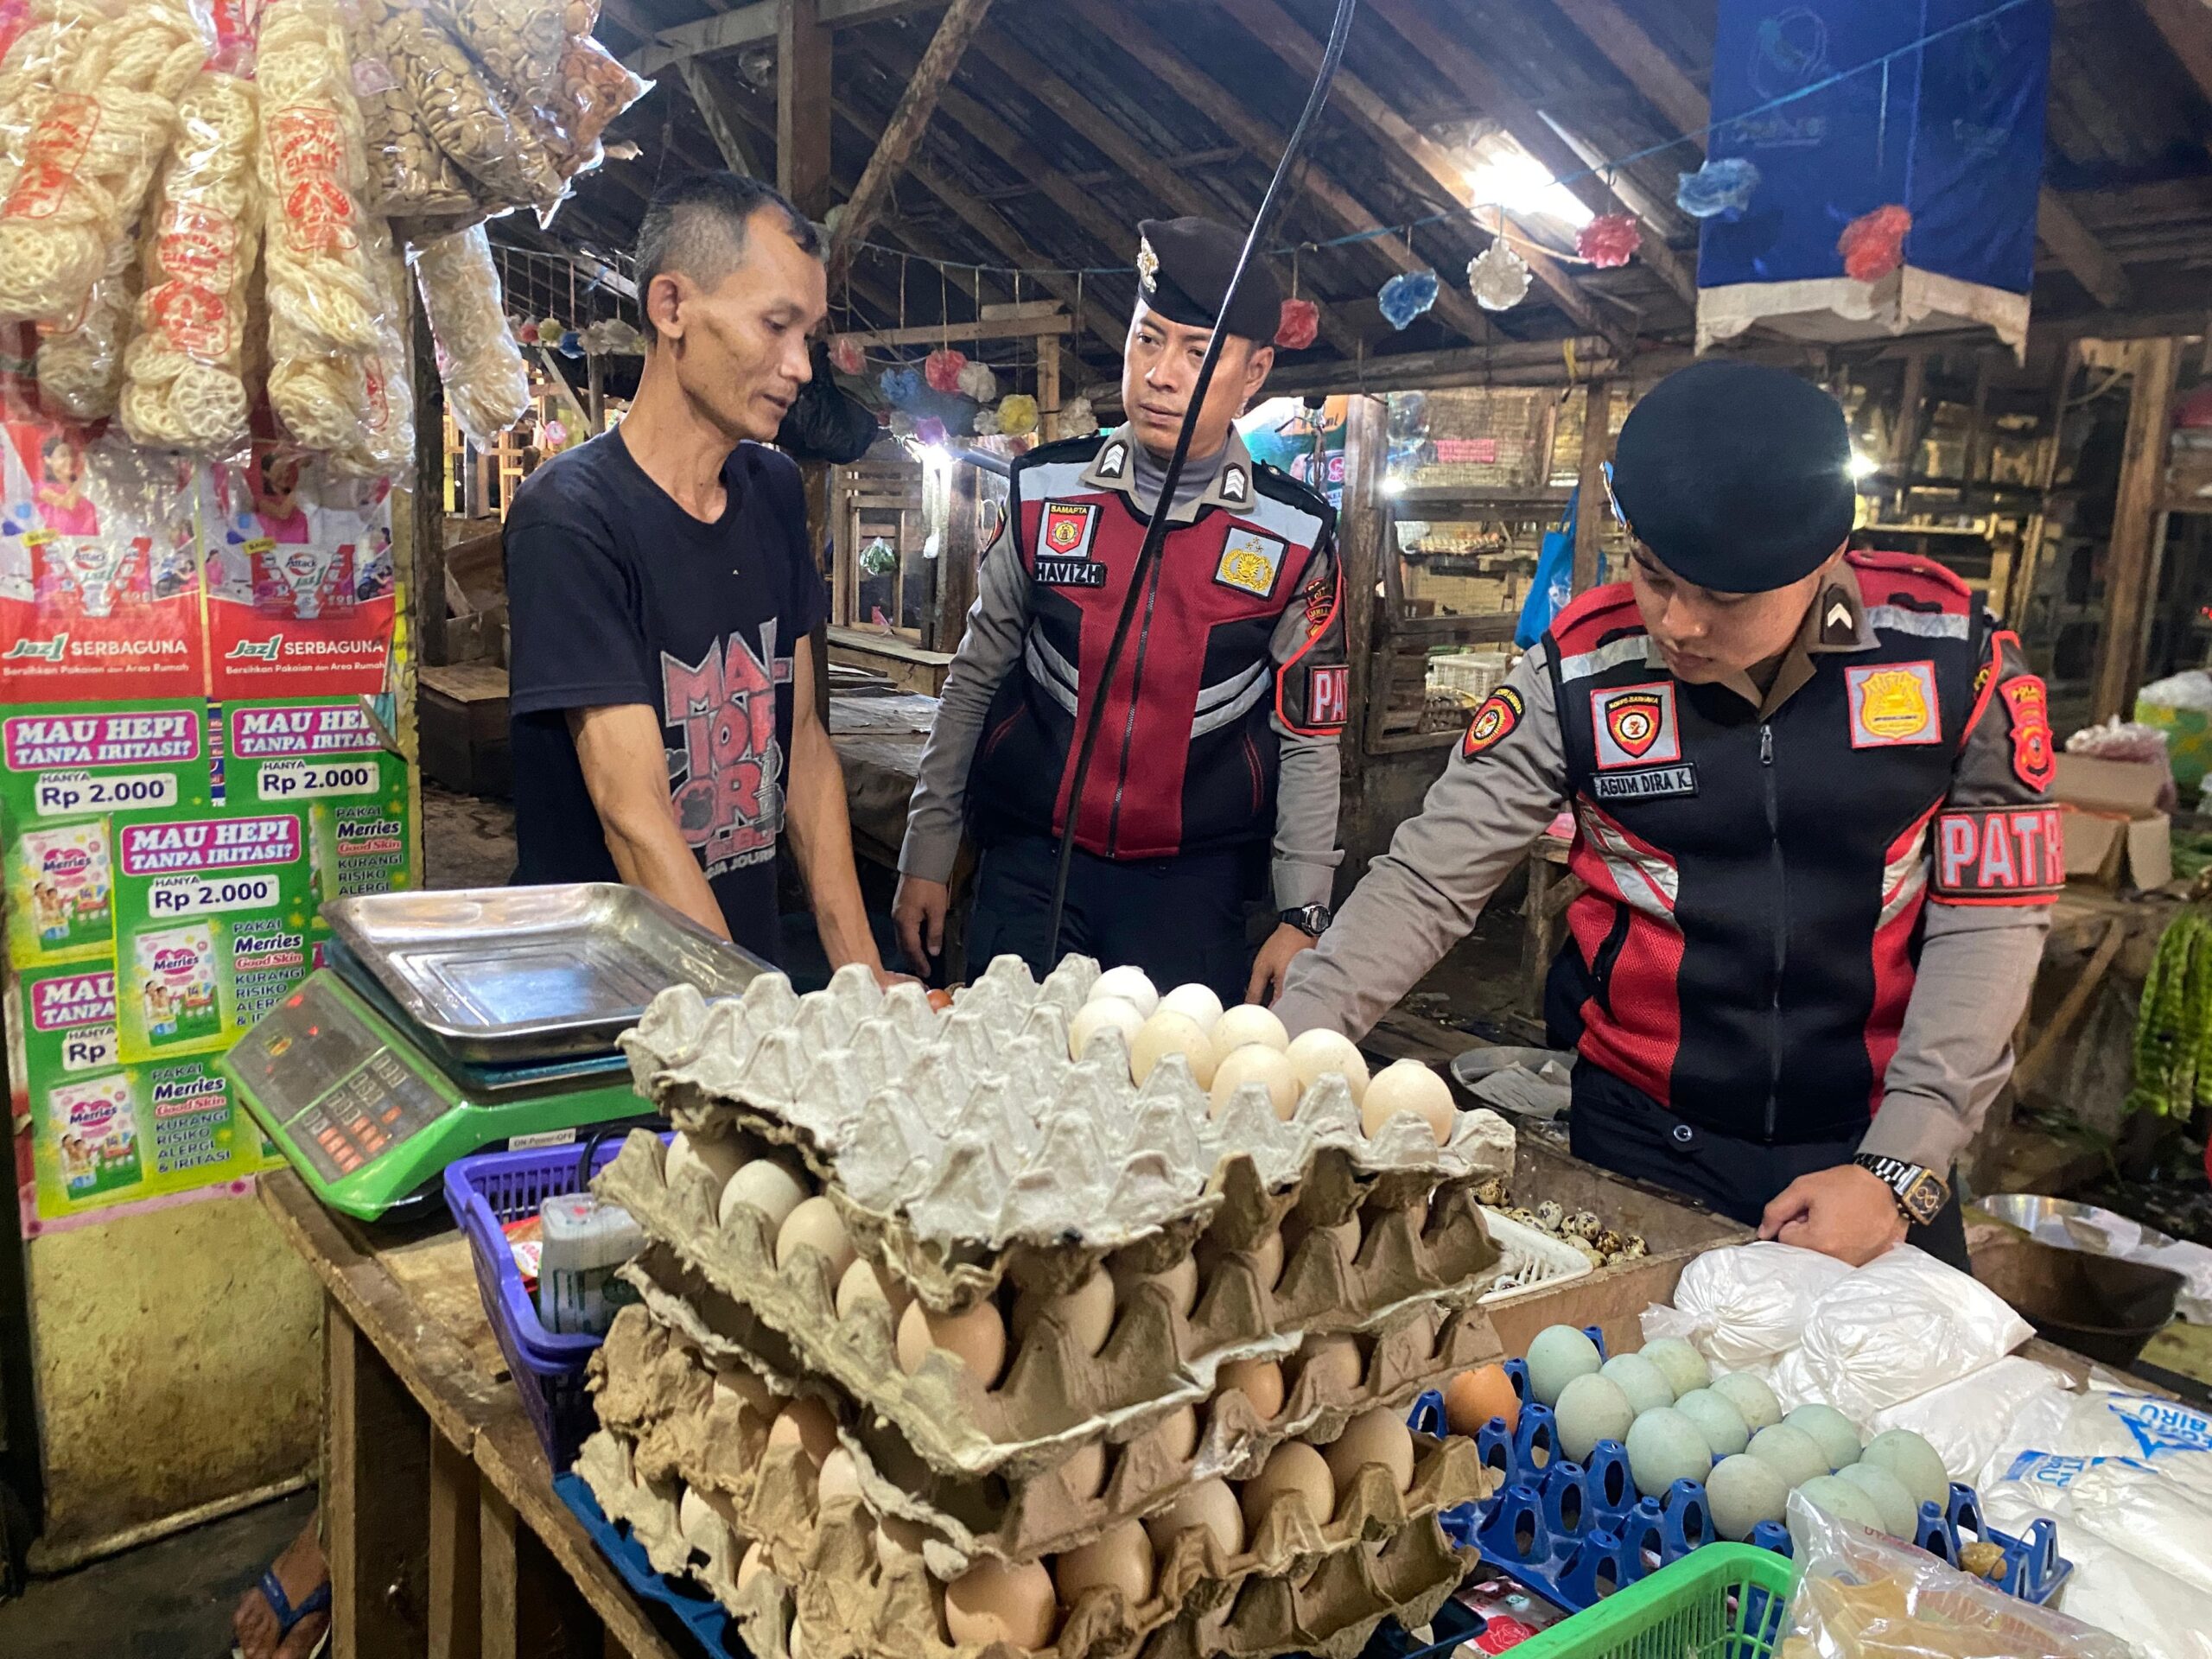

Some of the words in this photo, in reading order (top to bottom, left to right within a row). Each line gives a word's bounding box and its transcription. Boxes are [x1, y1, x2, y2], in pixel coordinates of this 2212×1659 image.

[1051, 505, 1088, 514] SAMAPTA
[1036, 563, 1101, 584] HAVIZH
[71, 640, 188, 656] SERBAGUNA
[284, 640, 385, 655] SERBAGUNA
[3, 666, 58, 677] Bersihkan
[60, 664, 105, 675] Pakaian
[125, 664, 150, 673] Area
[154, 663, 188, 672] Rumah
[226, 664, 273, 675] Bersihkan
[276, 664, 313, 673] Pakaian
[331, 662, 353, 671] Area
[354, 661, 385, 671] Rumah
[1313, 670, 1348, 722] PA
[16, 719, 98, 746] MAU
[106, 716, 187, 741] HEPI
[242, 712, 313, 734] MAU
[16, 747, 92, 765] TANPA
[98, 741, 192, 760] IRITASI?
[242, 736, 307, 753] TANPA
[263, 761, 305, 770] HANYA
[41, 772, 90, 783] HANYA
[264, 774, 296, 794] Rp
[304, 768, 368, 789] 2.000
[1600, 777, 1639, 796] AGUM
[1641, 772, 1674, 792] DIRA
[1677, 770, 1690, 788] K
[42, 786, 79, 809] Rp
[88, 780, 164, 803] 2.000
[336, 807, 381, 817] PAKAI
[130, 826, 208, 851] MAU
[215, 821, 289, 845] HEPI
[338, 820, 399, 839] Merries
[339, 842, 372, 855] Good
[373, 839, 401, 851] Skin
[44, 856, 92, 872] Merries
[130, 850, 201, 870] TANPA
[207, 844, 293, 863] IRITASI?
[339, 855, 402, 868] KURANGI
[155, 876, 200, 887] HANYA
[339, 870, 386, 882] RISIKO
[155, 890, 190, 911] Rp
[199, 882, 267, 905] 2.000
[339, 883, 389, 896] ALERGI
[234, 919, 281, 932] PAKAI
[235, 934, 302, 953] Merries
[154, 957, 199, 971] Merries
[236, 955, 270, 969] Good
[272, 953, 302, 964] Skin
[236, 968, 304, 984] KURANGI
[237, 984, 287, 998] RISIKO
[41, 1001, 116, 1026] TANPA
[237, 1015, 245, 1025] &
[69, 1027, 115, 1039] HANYA
[70, 1043, 105, 1063] Rp
[152, 1064, 201, 1079] PAKAI
[155, 1078, 224, 1101] Merries
[156, 1099, 192, 1116] Good
[194, 1096, 226, 1108] Skin
[70, 1106, 117, 1124] Merries
[156, 1111, 228, 1131] KURANGI
[157, 1128, 210, 1145] RISIKO
[159, 1141, 214, 1159] ALERGI
[158, 1164, 168, 1173] &
[175, 1150, 230, 1169] IRITASI
